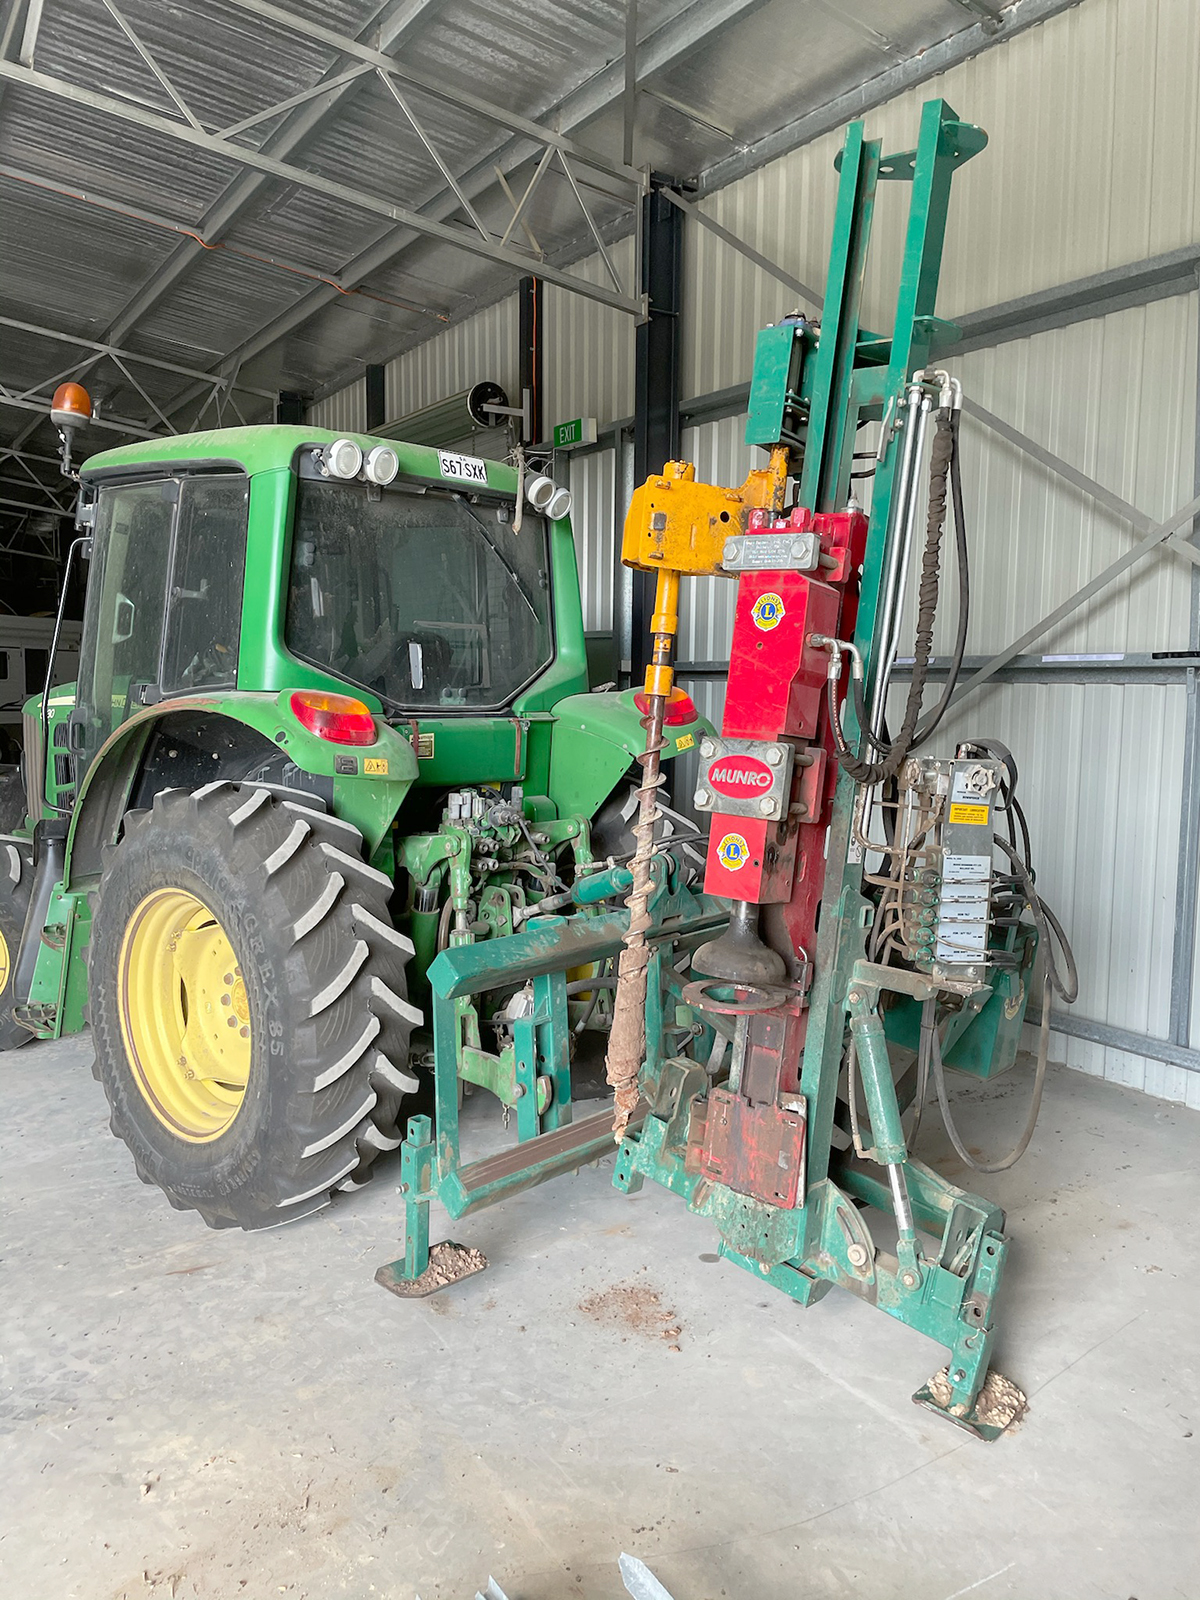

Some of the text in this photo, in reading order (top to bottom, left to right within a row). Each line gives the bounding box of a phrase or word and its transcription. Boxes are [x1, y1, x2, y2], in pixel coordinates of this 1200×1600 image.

[560, 424, 576, 444] EXIT
[711, 767, 771, 787] MUNRO
[269, 1020, 285, 1056] 85
